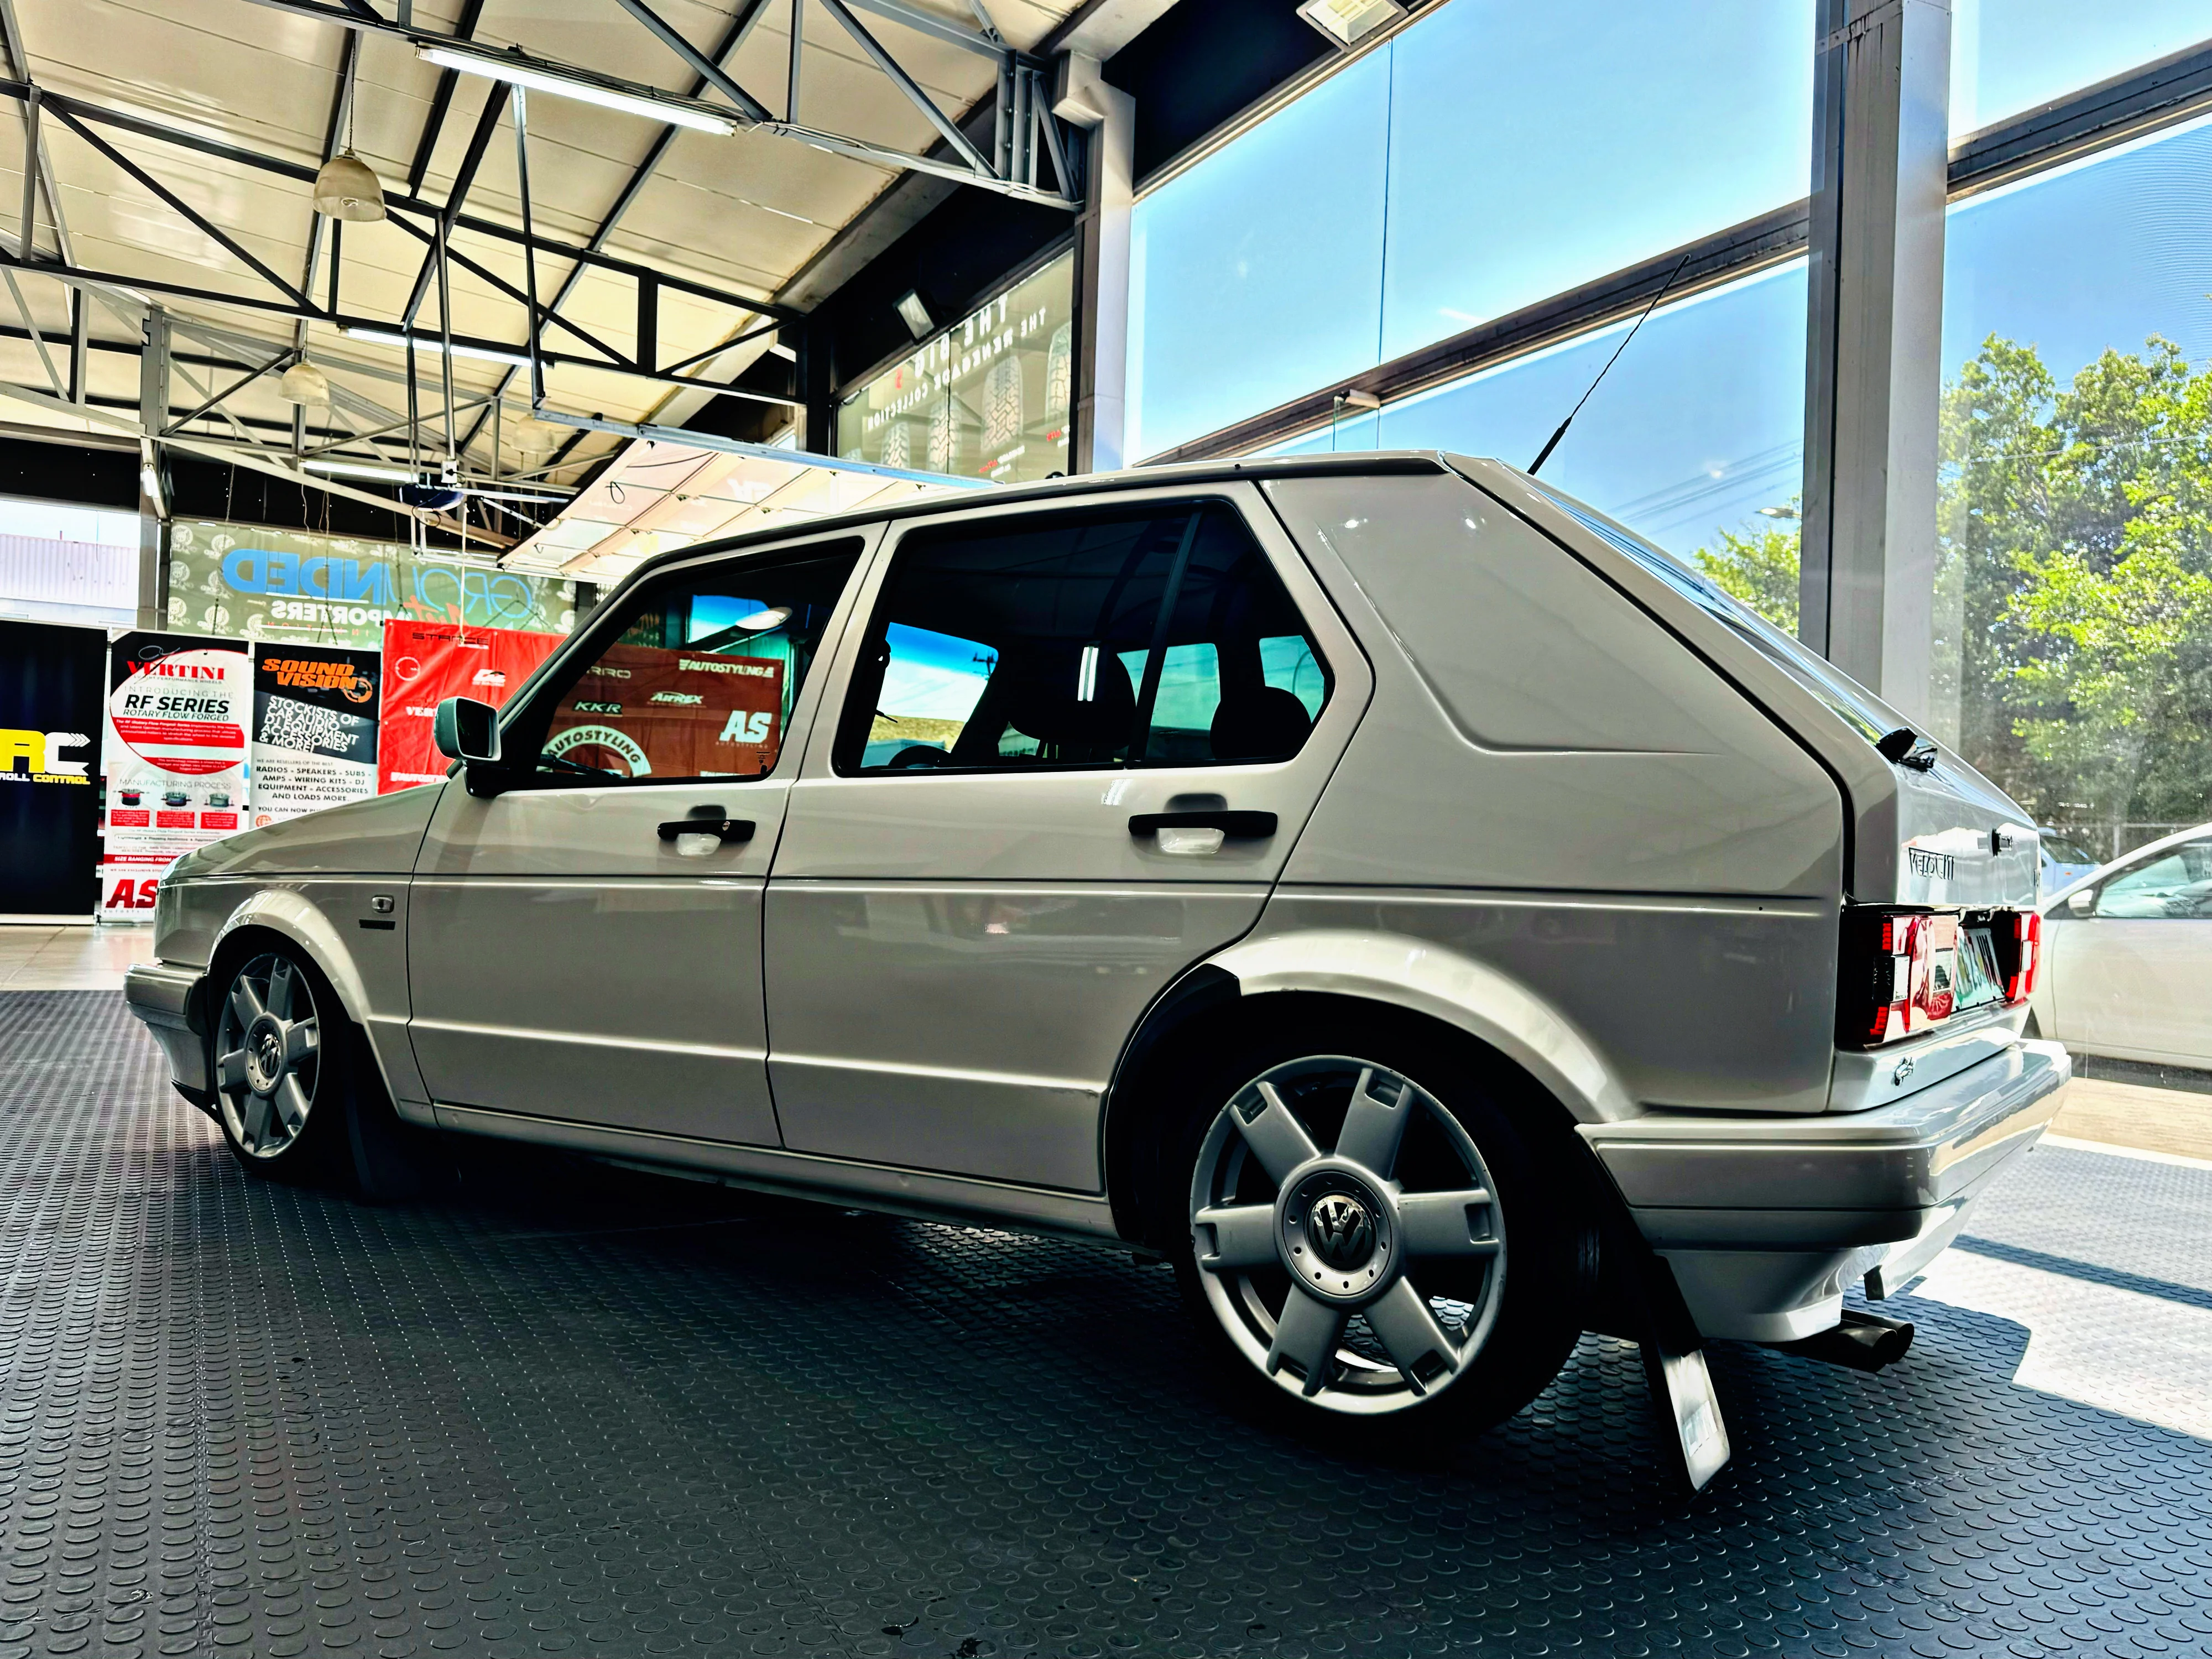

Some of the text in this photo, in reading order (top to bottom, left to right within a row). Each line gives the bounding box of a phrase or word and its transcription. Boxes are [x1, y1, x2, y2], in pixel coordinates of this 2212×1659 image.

[412, 633, 489, 645] STANCE
[127, 661, 226, 681] VERTINI
[262, 659, 354, 676] SOUND
[277, 672, 358, 690] VISION
[125, 686, 234, 699] INTRODUCING THE
[125, 694, 229, 714] RF SERIES
[269, 696, 359, 726] STOCKISTS OF
[575, 701, 622, 713] KKR
[123, 709, 229, 722] ROTARY FLOW FORGED
[267, 706, 340, 731] CAR AUDIO
[284, 718, 359, 745] EQUIPMENT
[719, 710, 772, 743] AS
[259, 732, 315, 753] & MORE!
[260, 724, 348, 752] ACCESSORIES
[547, 730, 641, 763] AUTOSTYLING
[33, 774, 91, 785] CONTROL
[119, 779, 231, 790] MANUFACTURING PROCESS
[106, 879, 159, 908] AS
